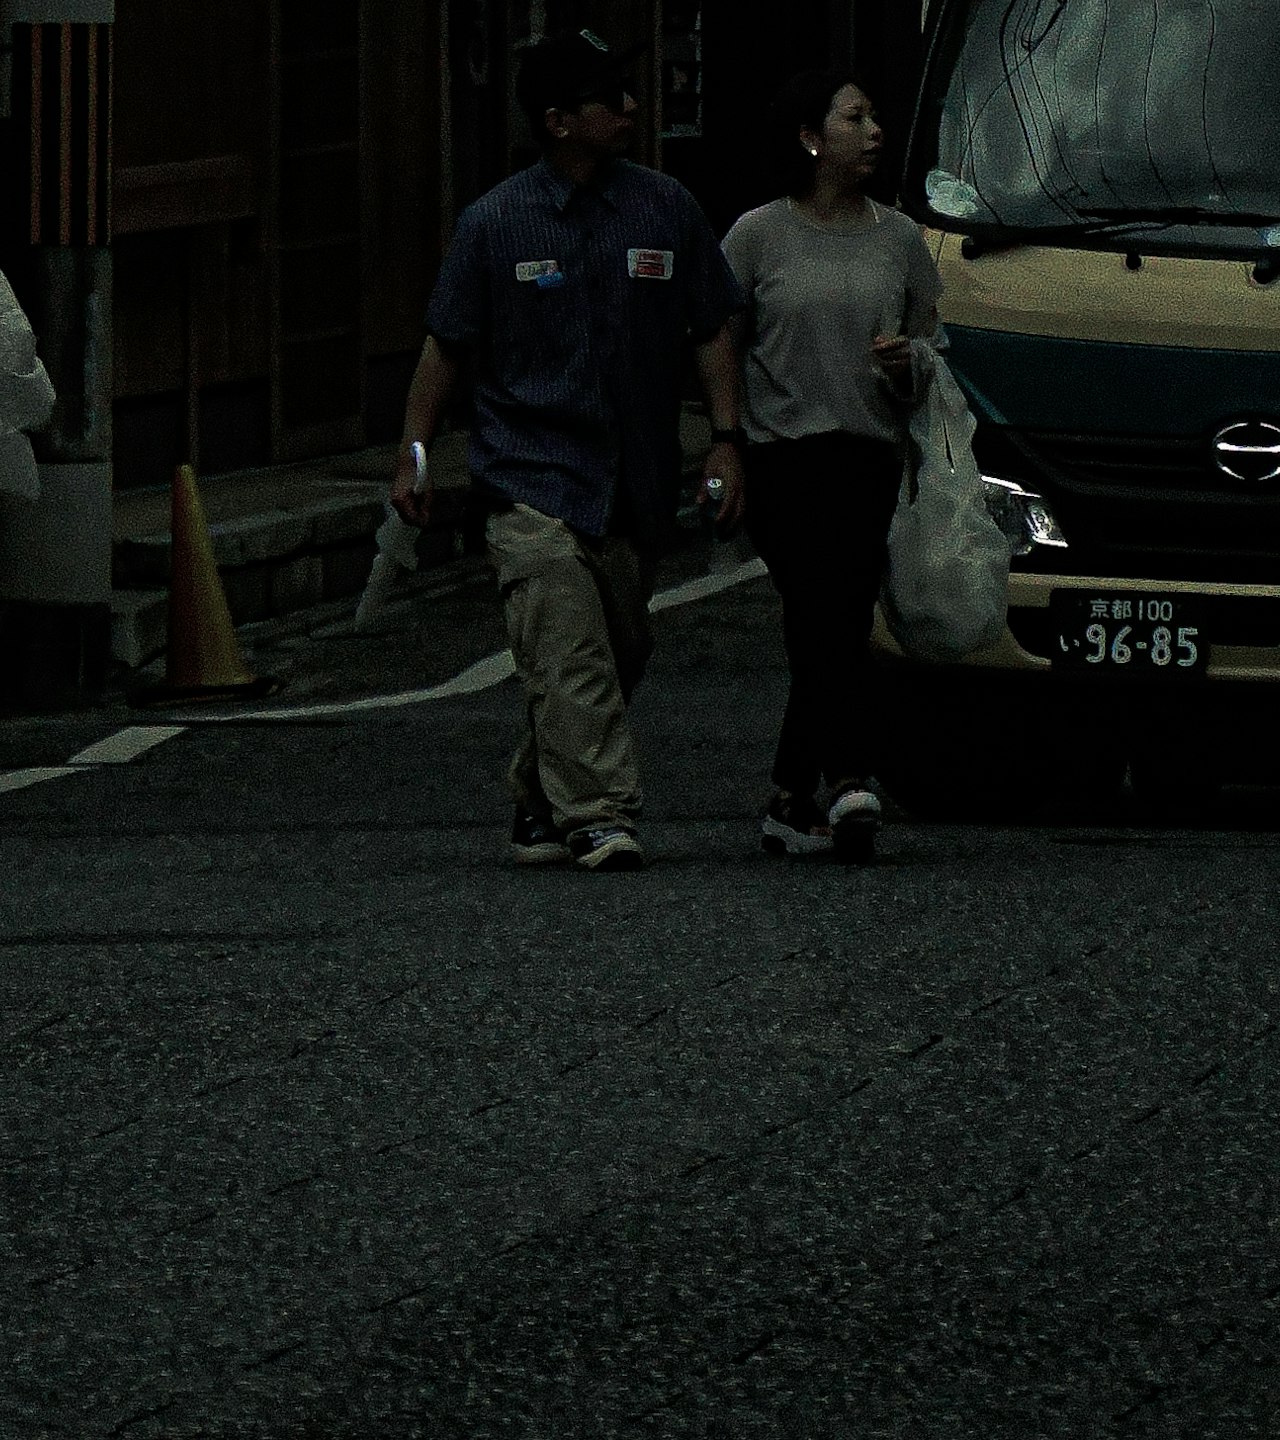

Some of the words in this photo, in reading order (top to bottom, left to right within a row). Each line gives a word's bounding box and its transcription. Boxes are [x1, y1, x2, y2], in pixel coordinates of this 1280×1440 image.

[1089, 597, 1133, 620] 京都
[1137, 599, 1173, 622] 100
[1084, 623, 1199, 667] 96-85
